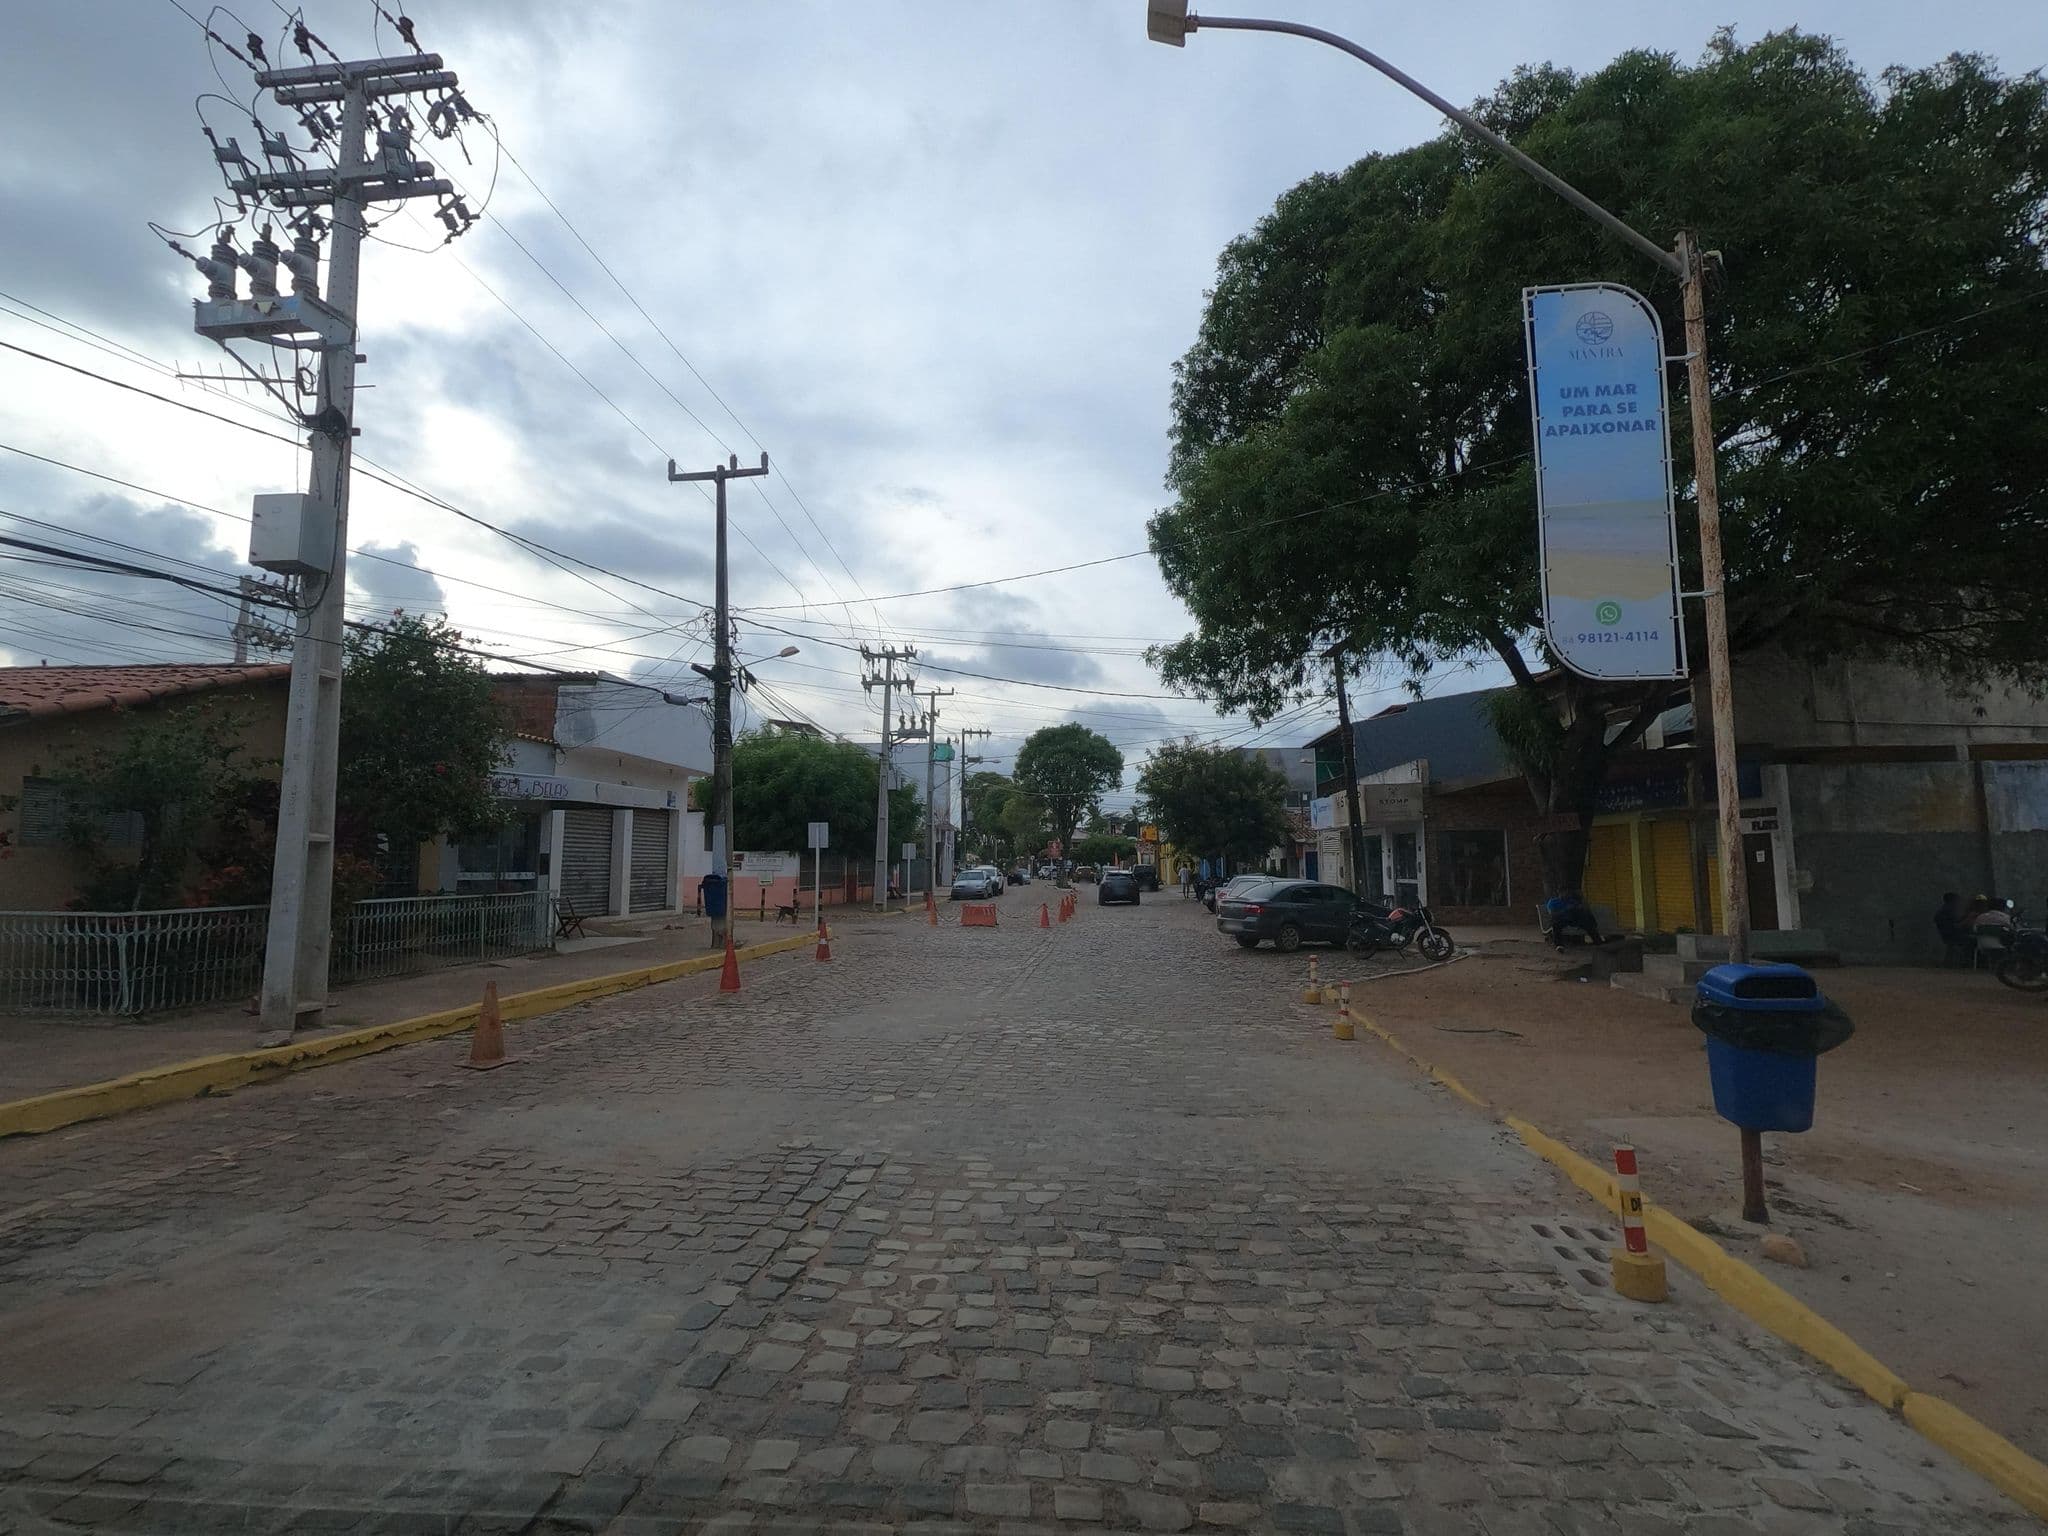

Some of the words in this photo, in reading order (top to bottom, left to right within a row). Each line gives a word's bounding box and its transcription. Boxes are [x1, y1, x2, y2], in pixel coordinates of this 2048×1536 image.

[1560, 386, 1589, 399] UM
[1595, 383, 1638, 397] MAR
[1562, 404, 1612, 418] PARA
[1616, 401, 1638, 415] SE
[1545, 420, 1656, 437] APAIXONAR
[1578, 630, 1659, 643] 98121-4114
